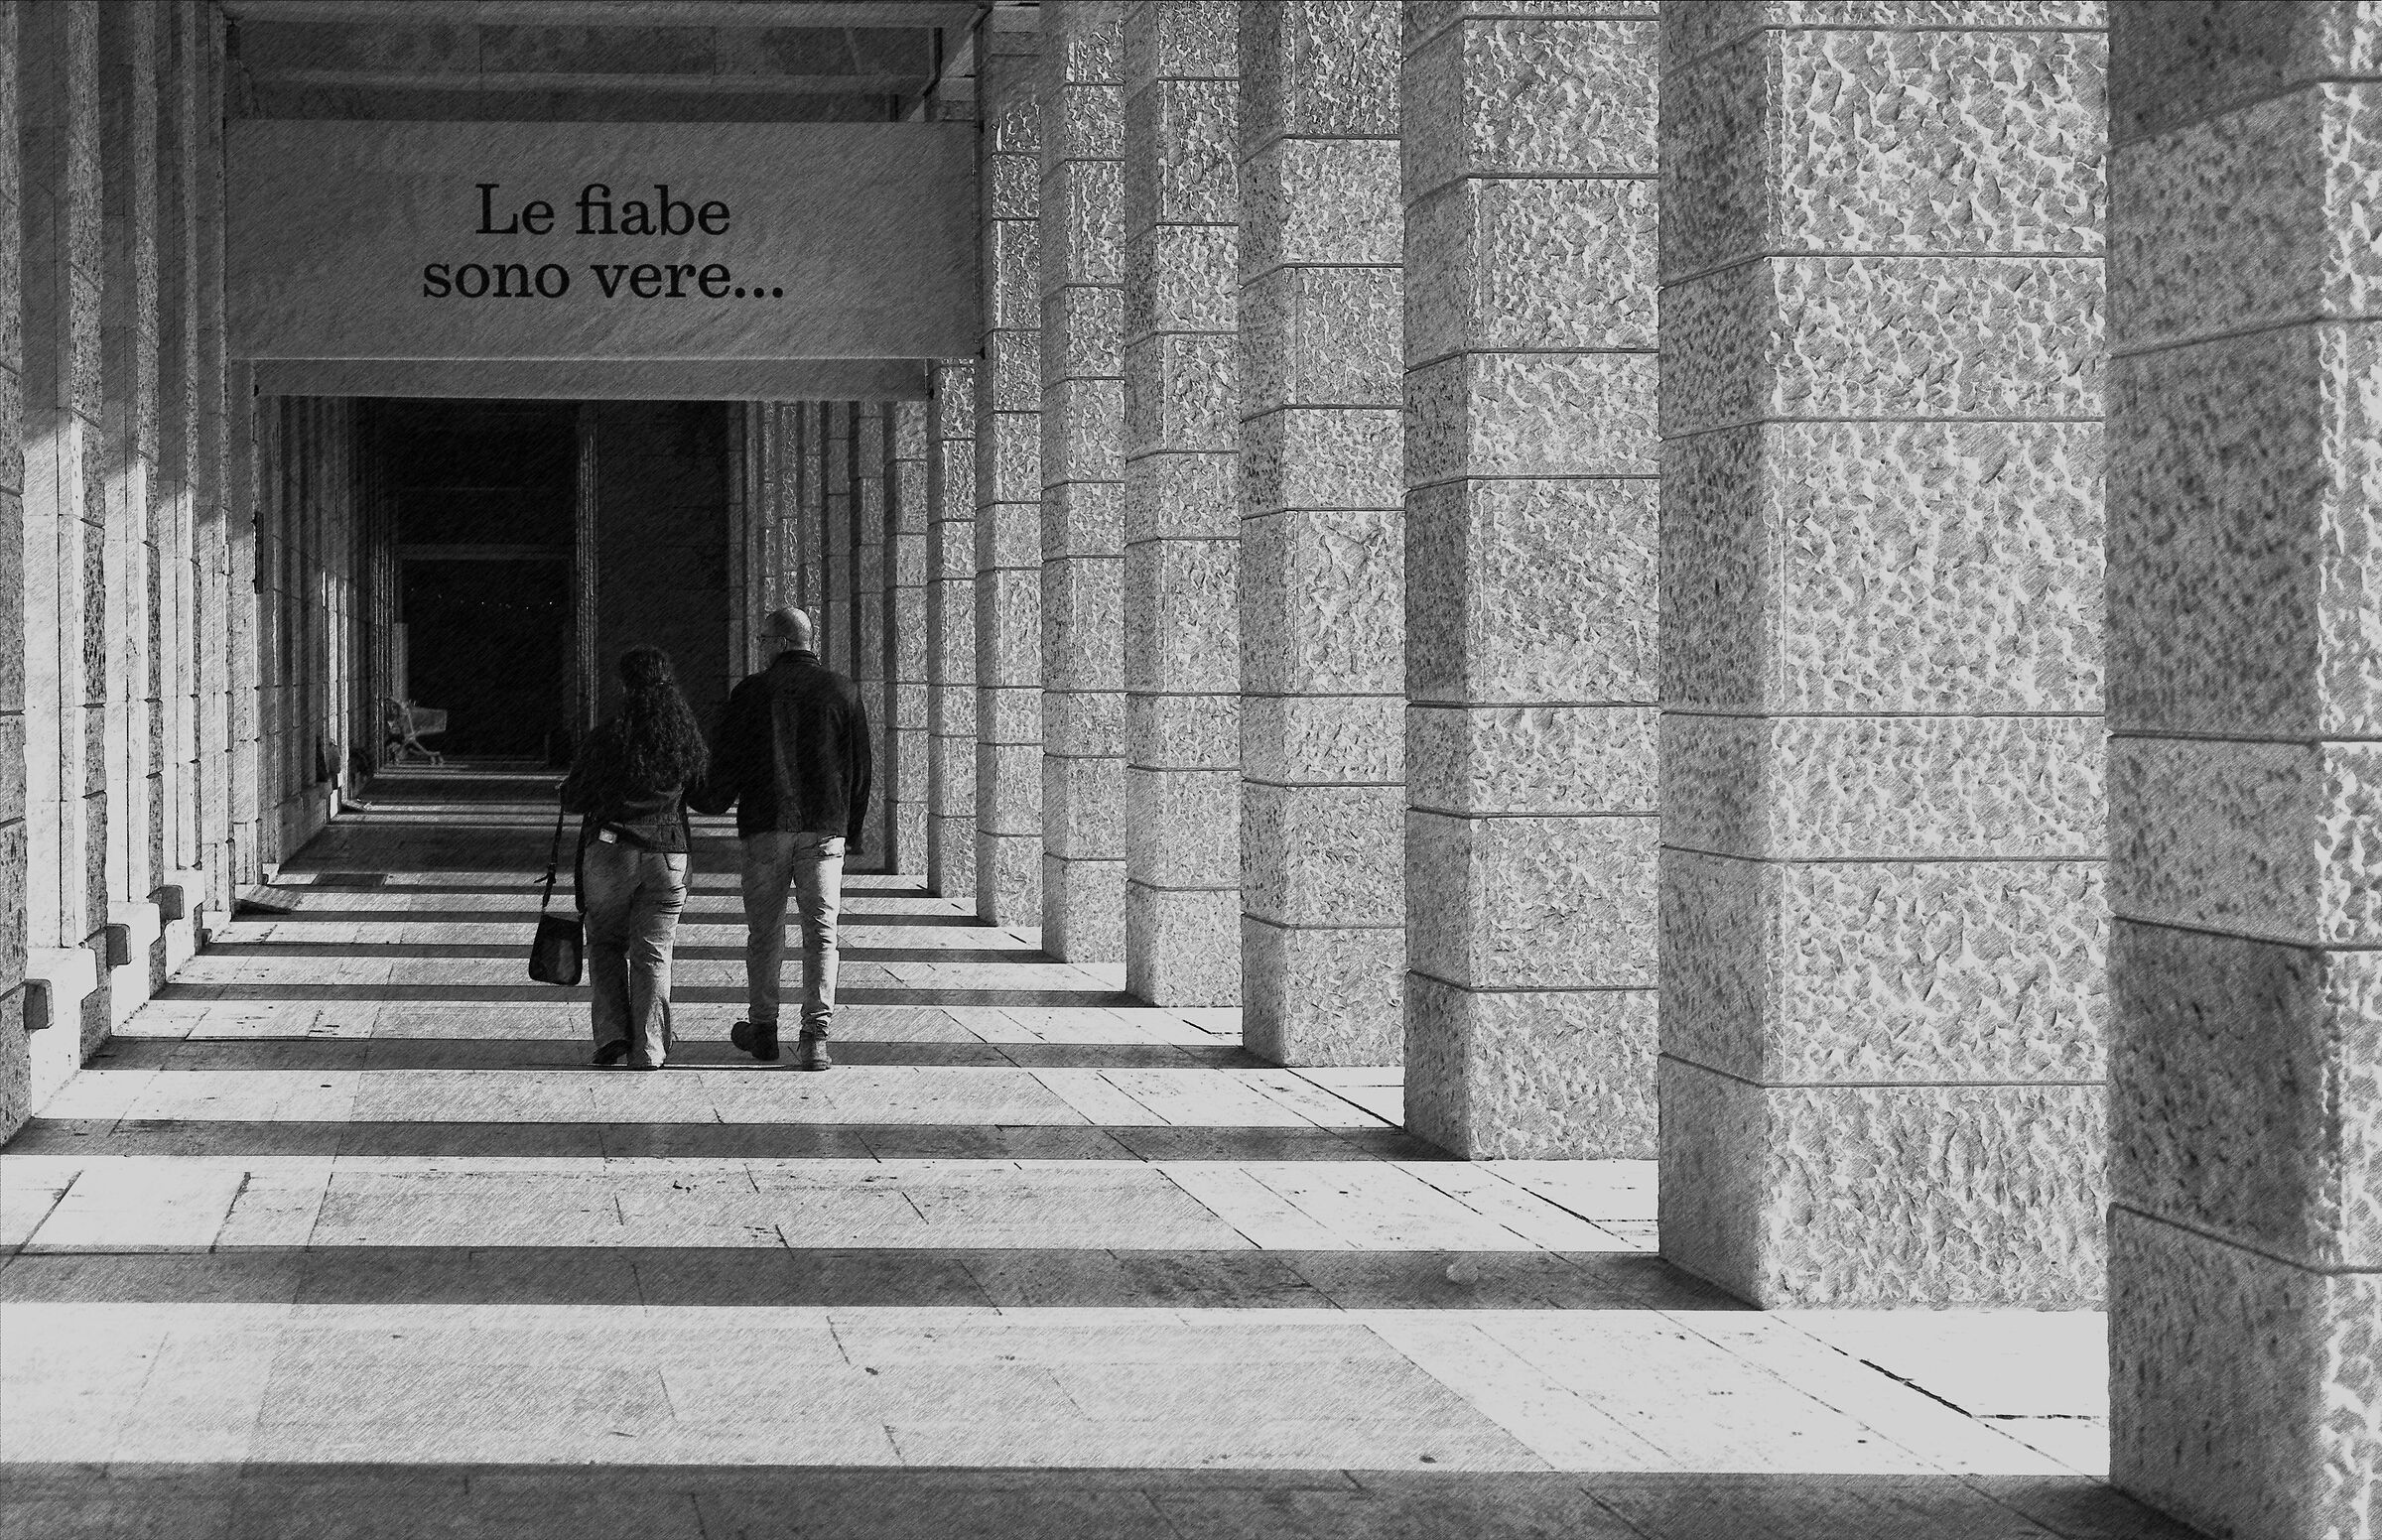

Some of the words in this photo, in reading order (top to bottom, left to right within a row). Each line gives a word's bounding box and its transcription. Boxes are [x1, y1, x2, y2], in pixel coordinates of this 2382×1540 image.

[474, 183, 555, 236] Le
[574, 183, 730, 236] fiabe
[423, 262, 571, 299] sono
[590, 263, 783, 299] vere...
